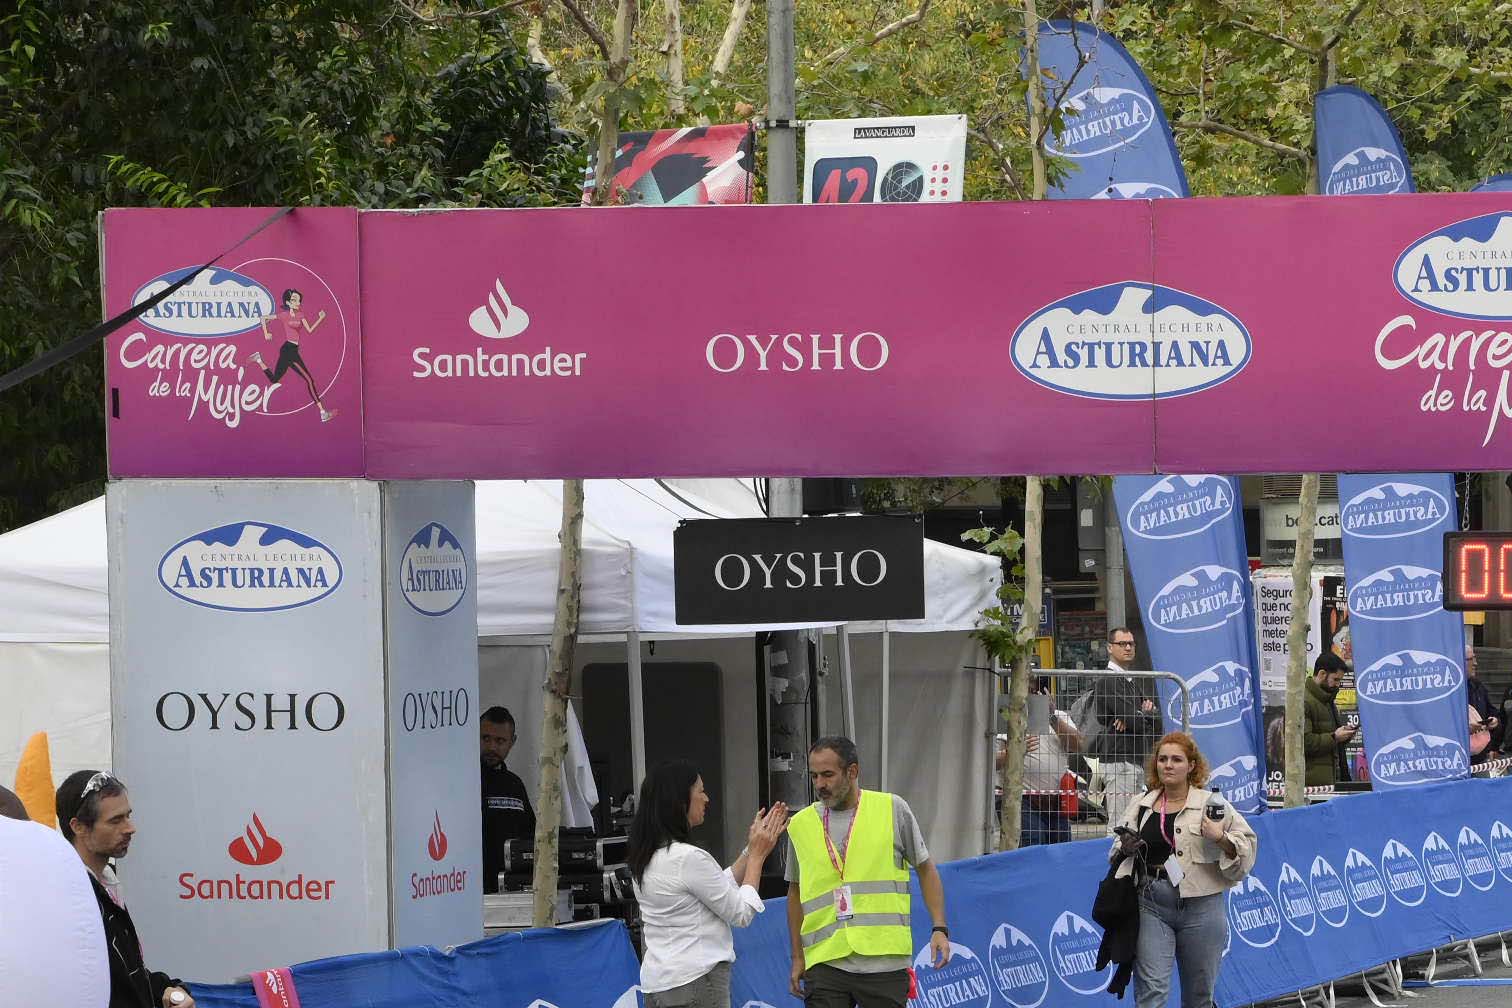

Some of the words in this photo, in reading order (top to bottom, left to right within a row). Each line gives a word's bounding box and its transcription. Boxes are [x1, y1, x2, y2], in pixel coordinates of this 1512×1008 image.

[866, 126, 914, 137] VANGUARDIA
[172, 289, 210, 298] ENTRAL
[212, 289, 259, 298] LECHERA
[1066, 323, 1141, 334] CENTRAL
[1149, 322, 1225, 334] LECHERA
[119, 332, 237, 370] Carrera
[412, 347, 587, 379] Santander
[705, 332, 889, 373] OYSHO
[1029, 326, 1233, 369] ASTURIANA
[149, 371, 171, 397] de
[175, 370, 191, 397] la
[188, 366, 282, 428] Mujer
[1420, 373, 1454, 412] de
[1462, 372, 1488, 412] la
[173, 555, 329, 588] ASTURIANA
[201, 553, 259, 562] CENTRAL
[264, 552, 323, 562] LECHERA
[714, 549, 887, 590] OYSHO
[405, 558, 464, 593] ASTURIANA
[1261, 602, 1278, 612] que
[1263, 640, 1281, 652] este
[155, 691, 345, 732] OYSHO
[402, 688, 469, 732] OYSHO
[179, 873, 335, 902] Santander
[411, 869, 467, 901] Santander
[995, 960, 1046, 992] ASTURIANA
